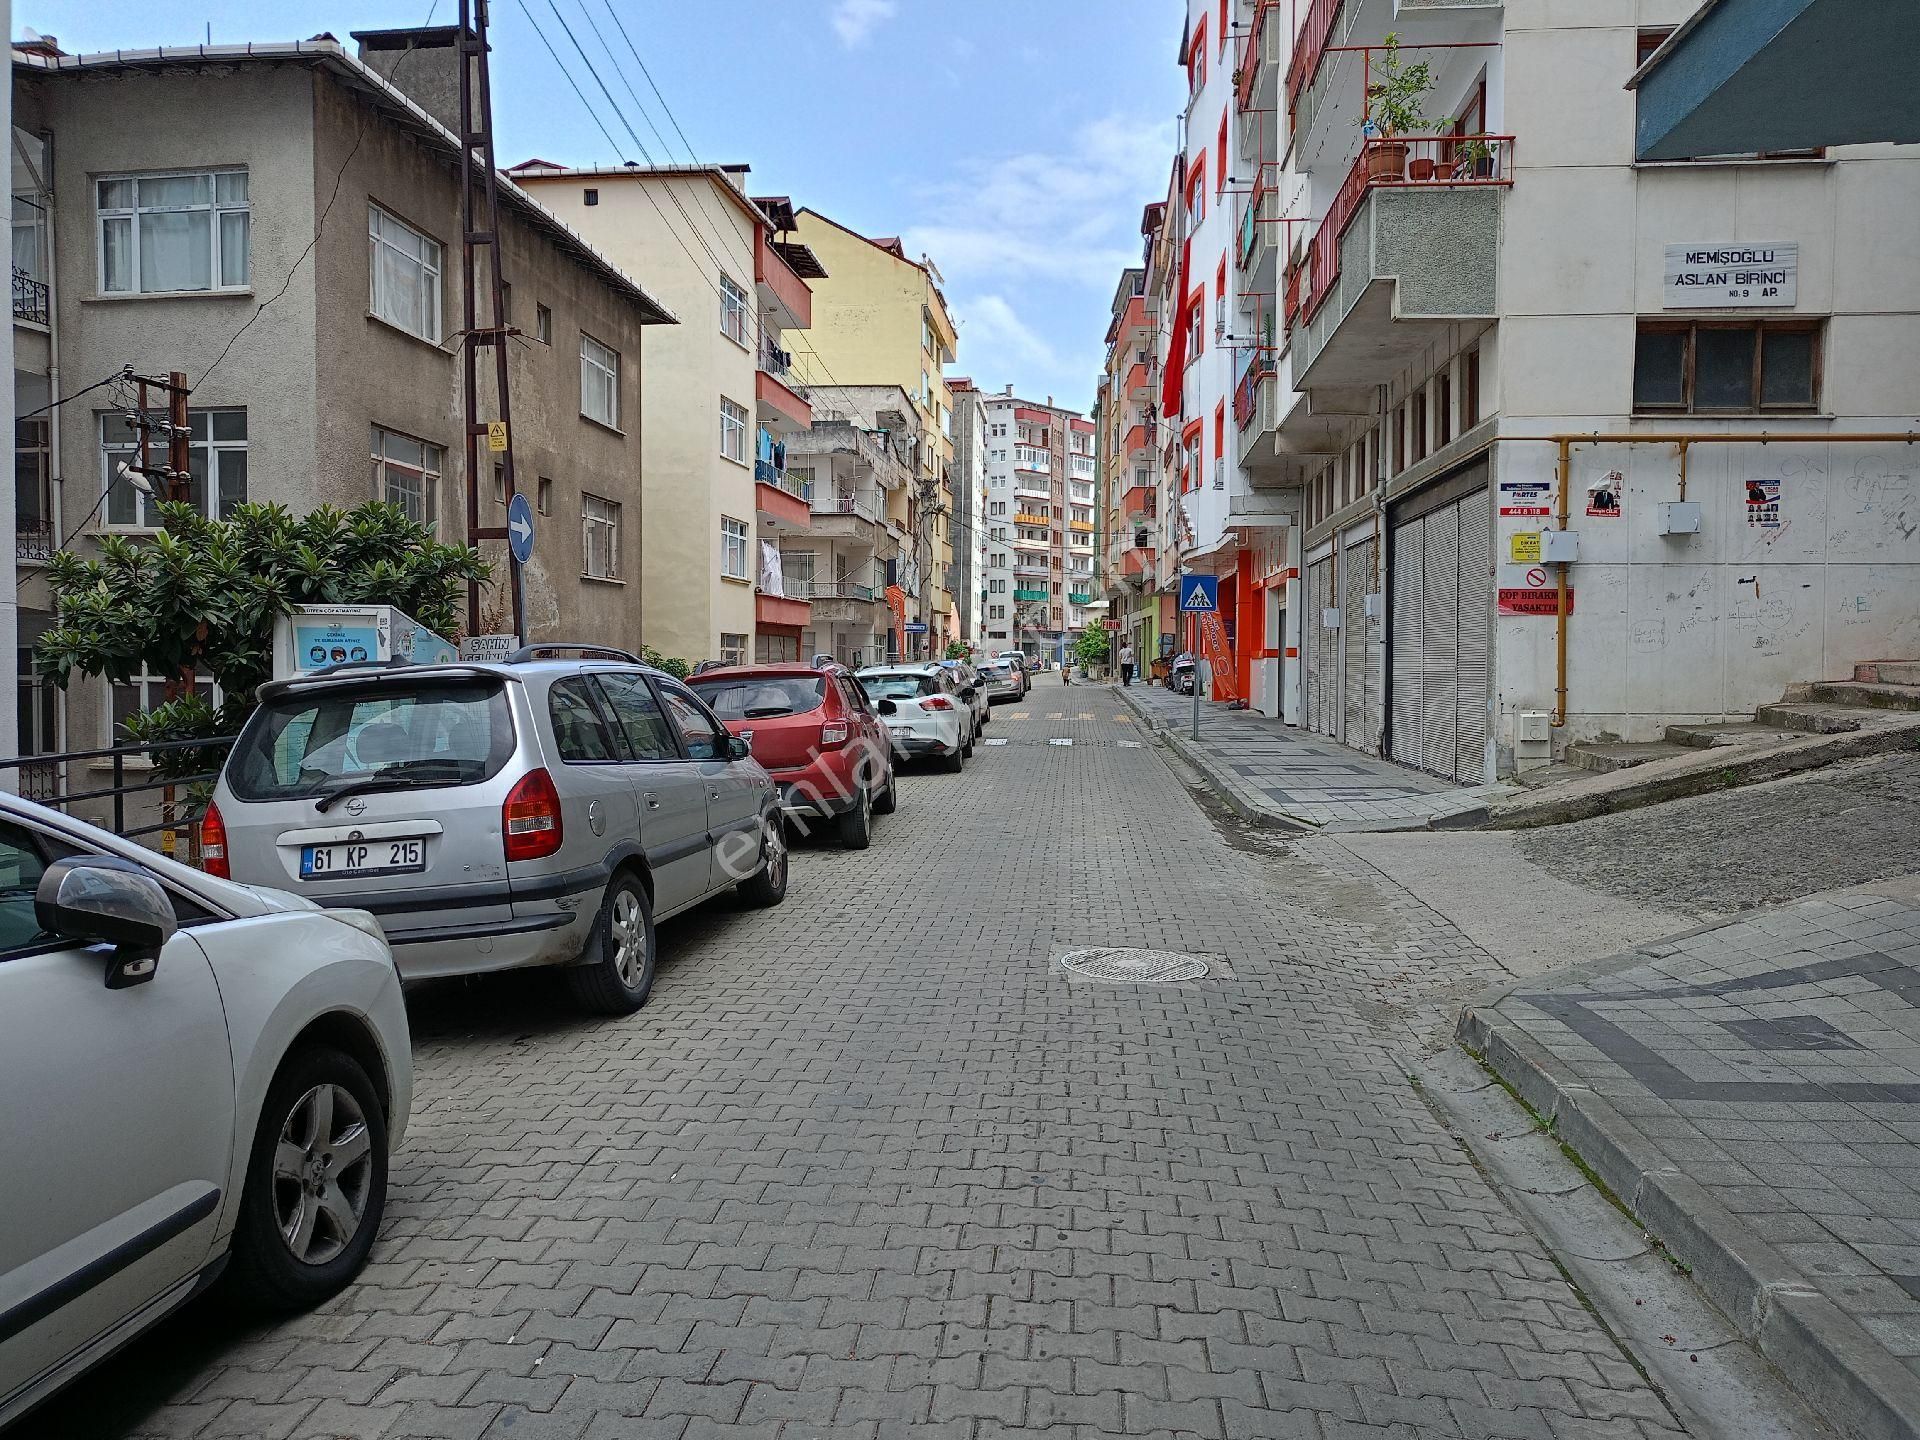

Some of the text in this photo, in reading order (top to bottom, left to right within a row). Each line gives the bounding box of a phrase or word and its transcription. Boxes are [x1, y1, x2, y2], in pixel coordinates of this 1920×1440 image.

[1685, 248, 1774, 265] MEMİŞOĞLU
[1675, 270, 1786, 286] ASLAN BİRİNCİ
[1521, 591, 1573, 600] BIRAKMK
[1102, 620, 1121, 630] FIRIN
[471, 636, 510, 652] ŞAHİN
[315, 849, 332, 870] 61
[346, 846, 368, 868] KP
[389, 842, 419, 865] 215
